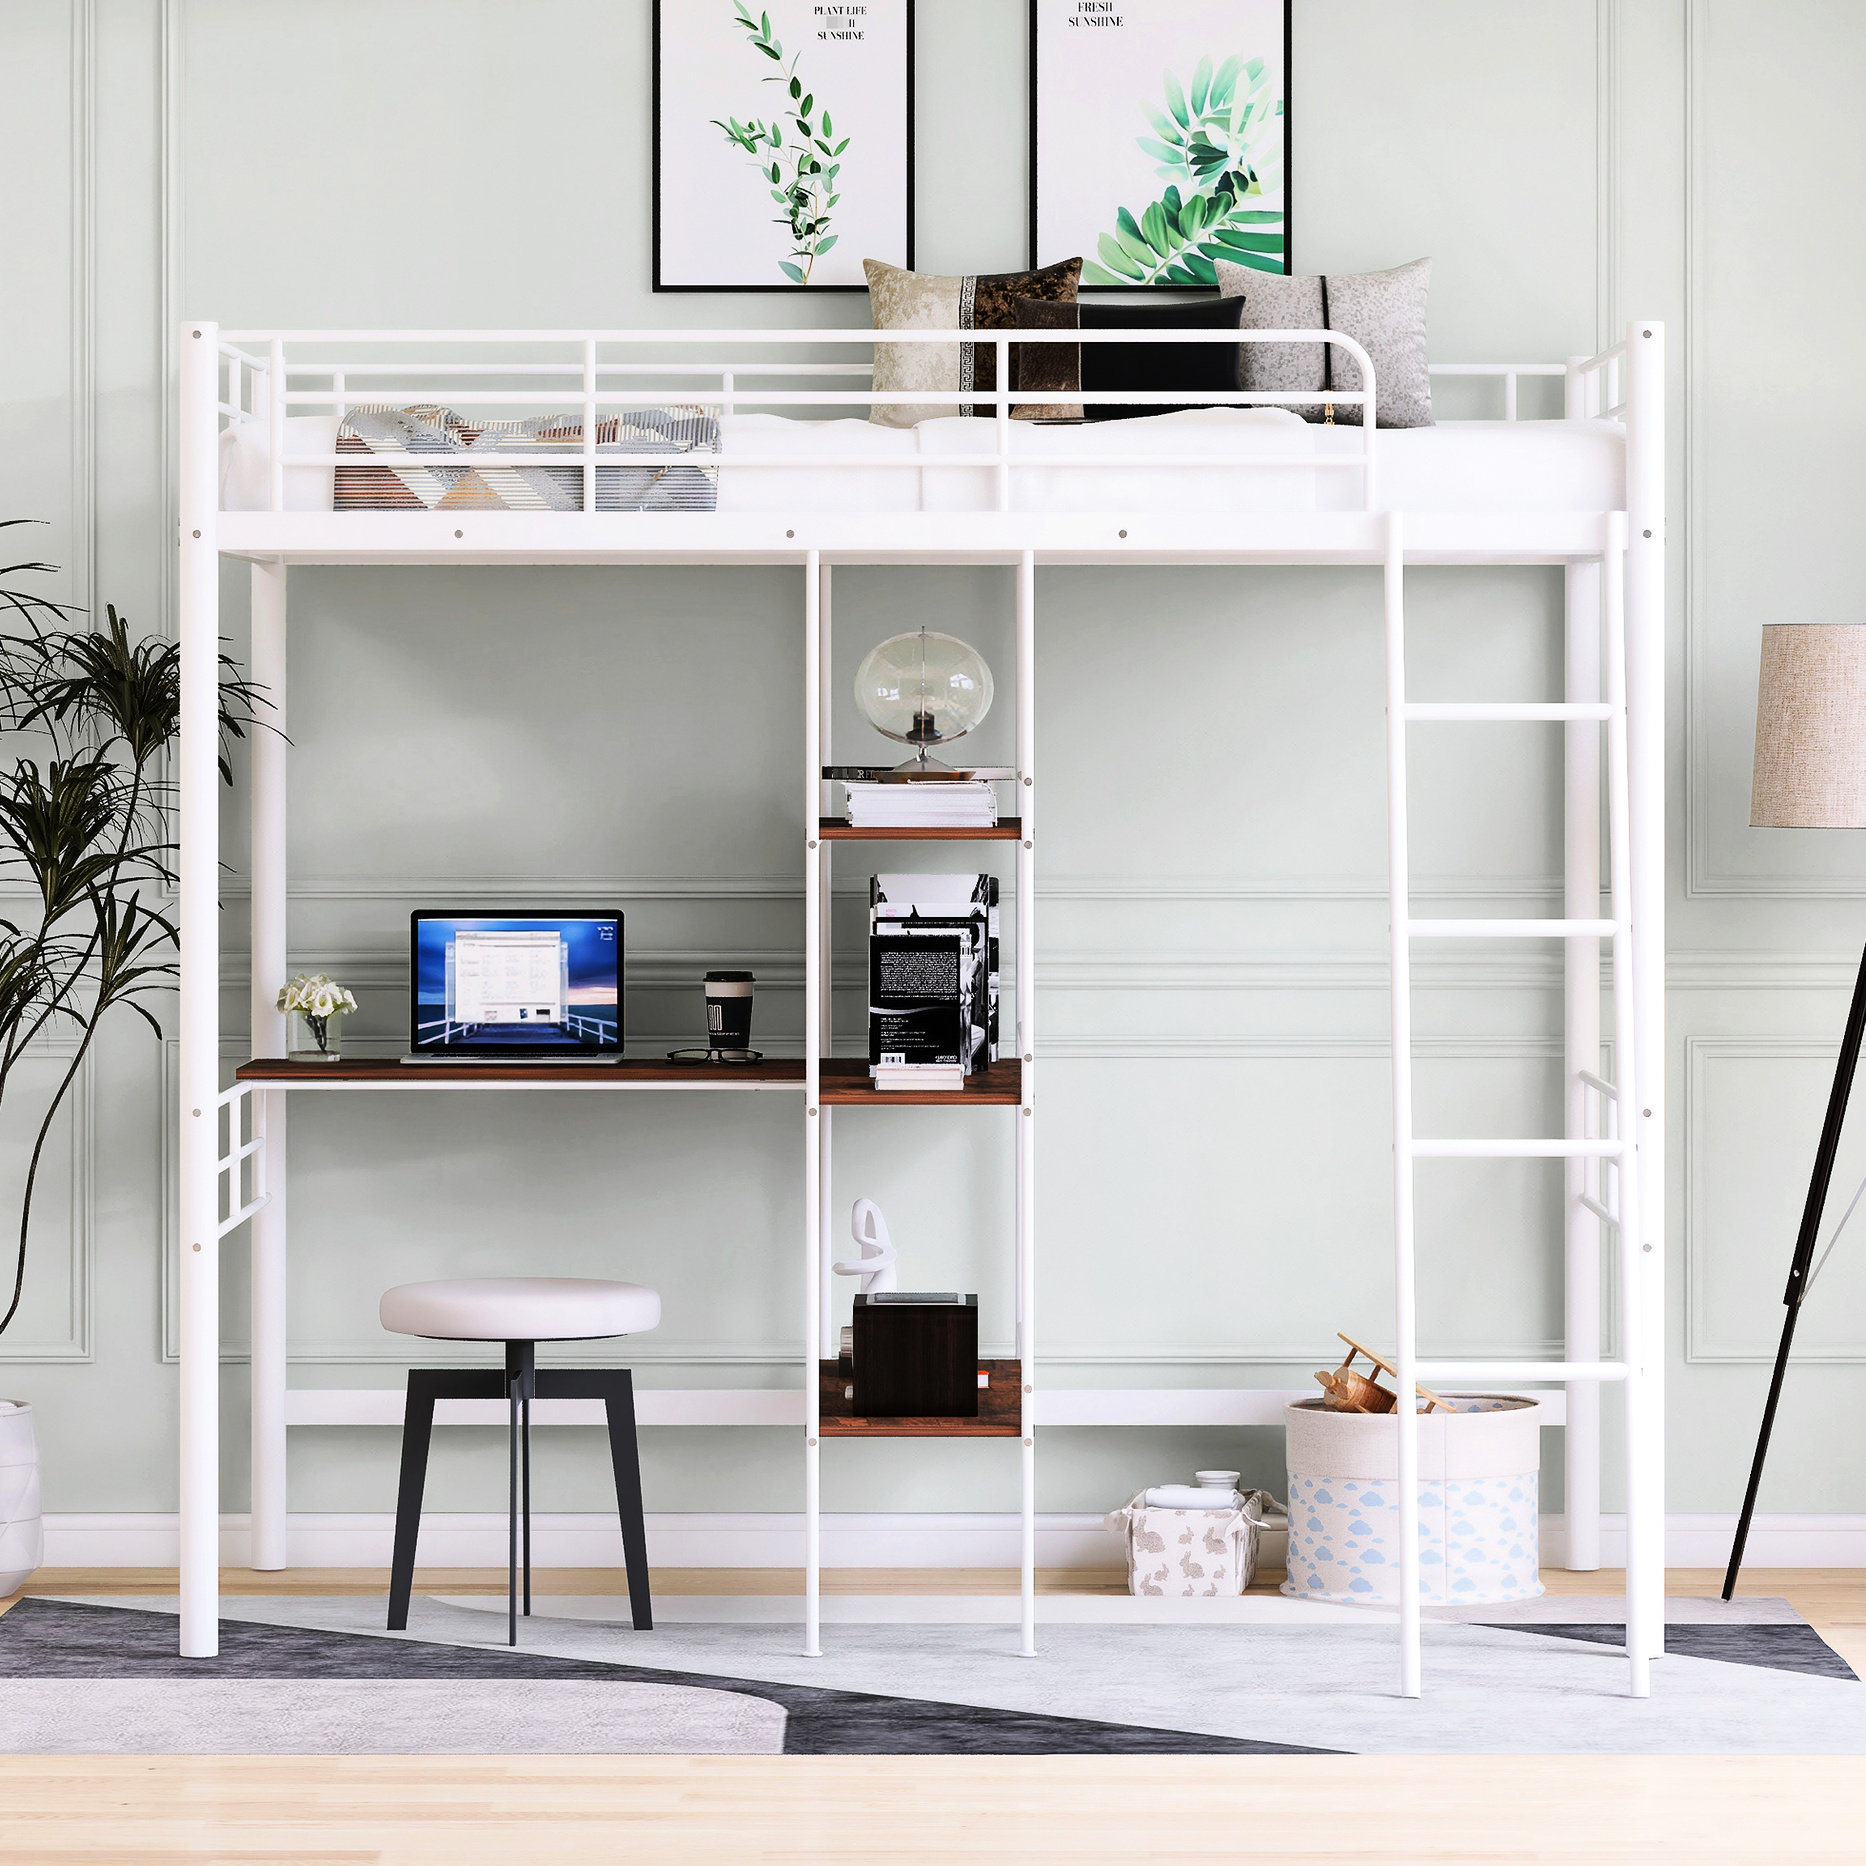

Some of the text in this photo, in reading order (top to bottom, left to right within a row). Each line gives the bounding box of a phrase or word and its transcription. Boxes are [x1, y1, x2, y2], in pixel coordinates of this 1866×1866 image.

[814, 6, 867, 15] PLANT LIFE
[1078, 2, 1112, 12] FRESH
[1068, 16, 1124, 27] SUNSHINE
[817, 31, 865, 40] SUNSHINE
